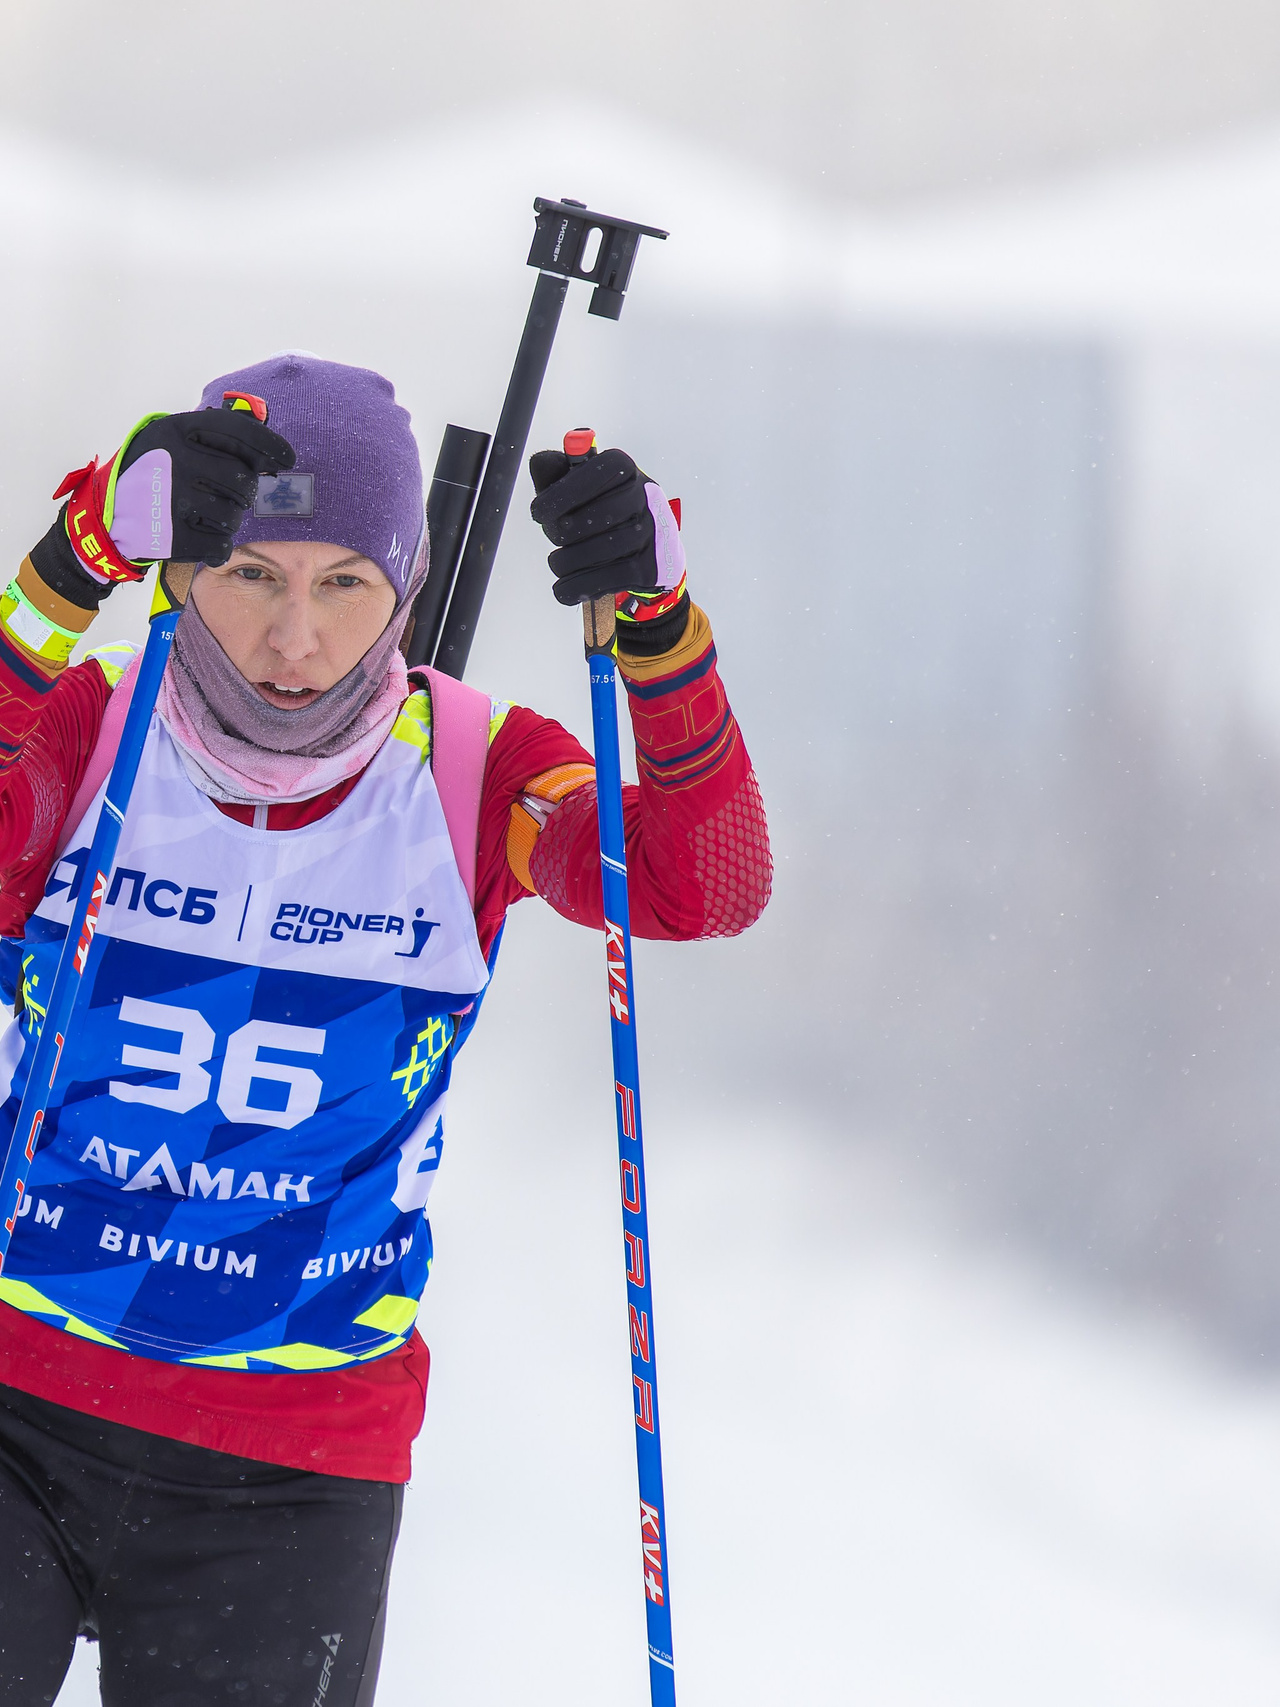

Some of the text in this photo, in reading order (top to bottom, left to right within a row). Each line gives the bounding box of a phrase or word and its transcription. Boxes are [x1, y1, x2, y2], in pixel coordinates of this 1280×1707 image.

[150, 467, 163, 551] NORDSKI
[73, 509, 128, 580] LEKI
[105, 867, 218, 925] ПСБ
[276, 903, 405, 936] PIONER
[270, 922, 344, 945] CUP
[108, 995, 326, 1130] 36
[99, 1223, 257, 1279] BIVIUM
[301, 1233, 413, 1280] BIVIUM
[615, 1080, 654, 1434] FORZA
